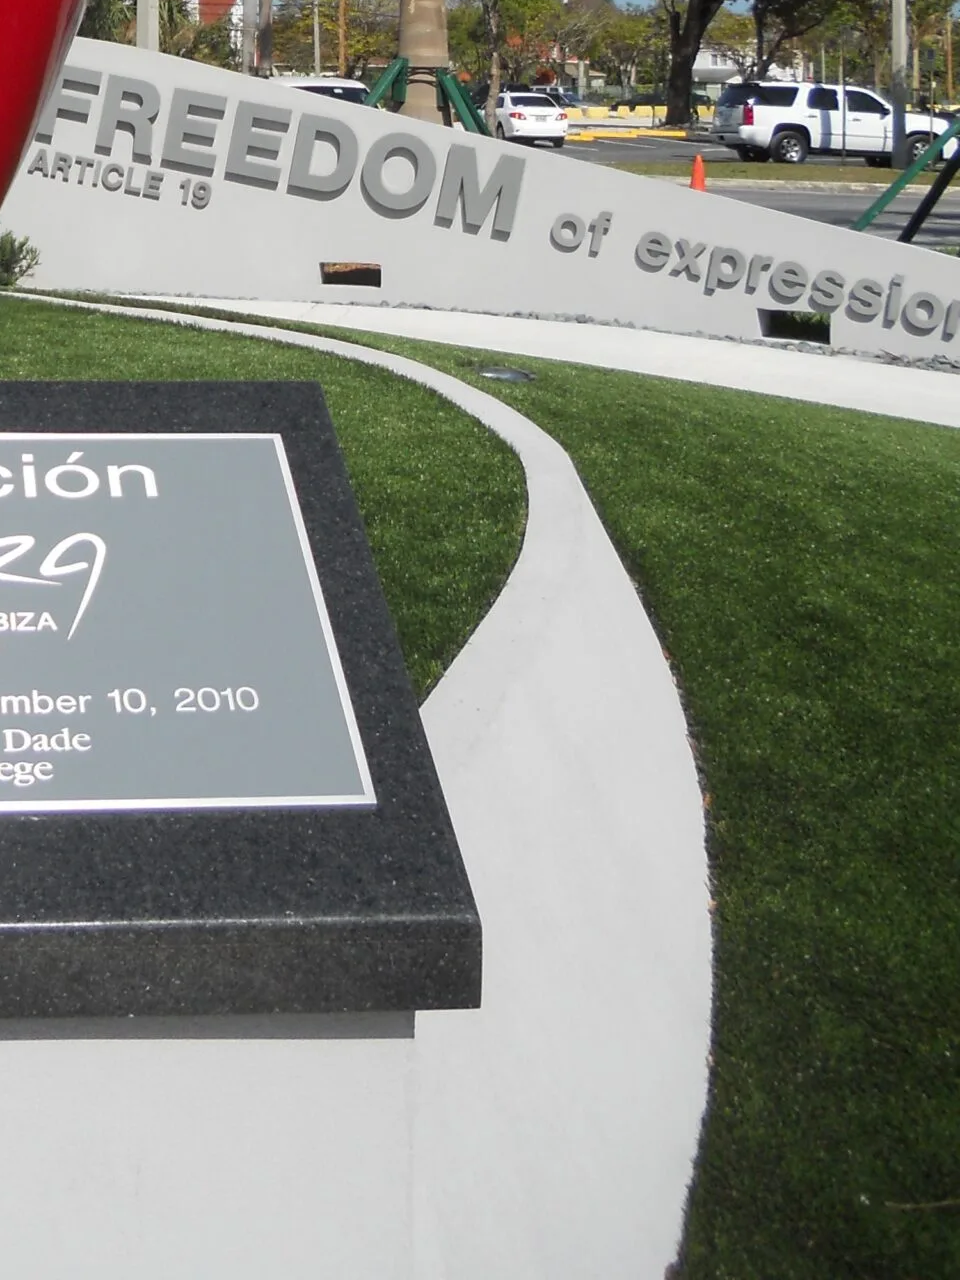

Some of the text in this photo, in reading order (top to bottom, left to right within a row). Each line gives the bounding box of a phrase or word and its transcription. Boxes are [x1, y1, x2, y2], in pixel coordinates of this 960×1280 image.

[27, 148, 212, 210] ARTICLE 19
[33, 65, 525, 243] FREEDOM
[550, 211, 614, 258] of
[107, 687, 157, 720] 10,
[173, 687, 260, 713] 2010
[2, 727, 92, 754] Dade
